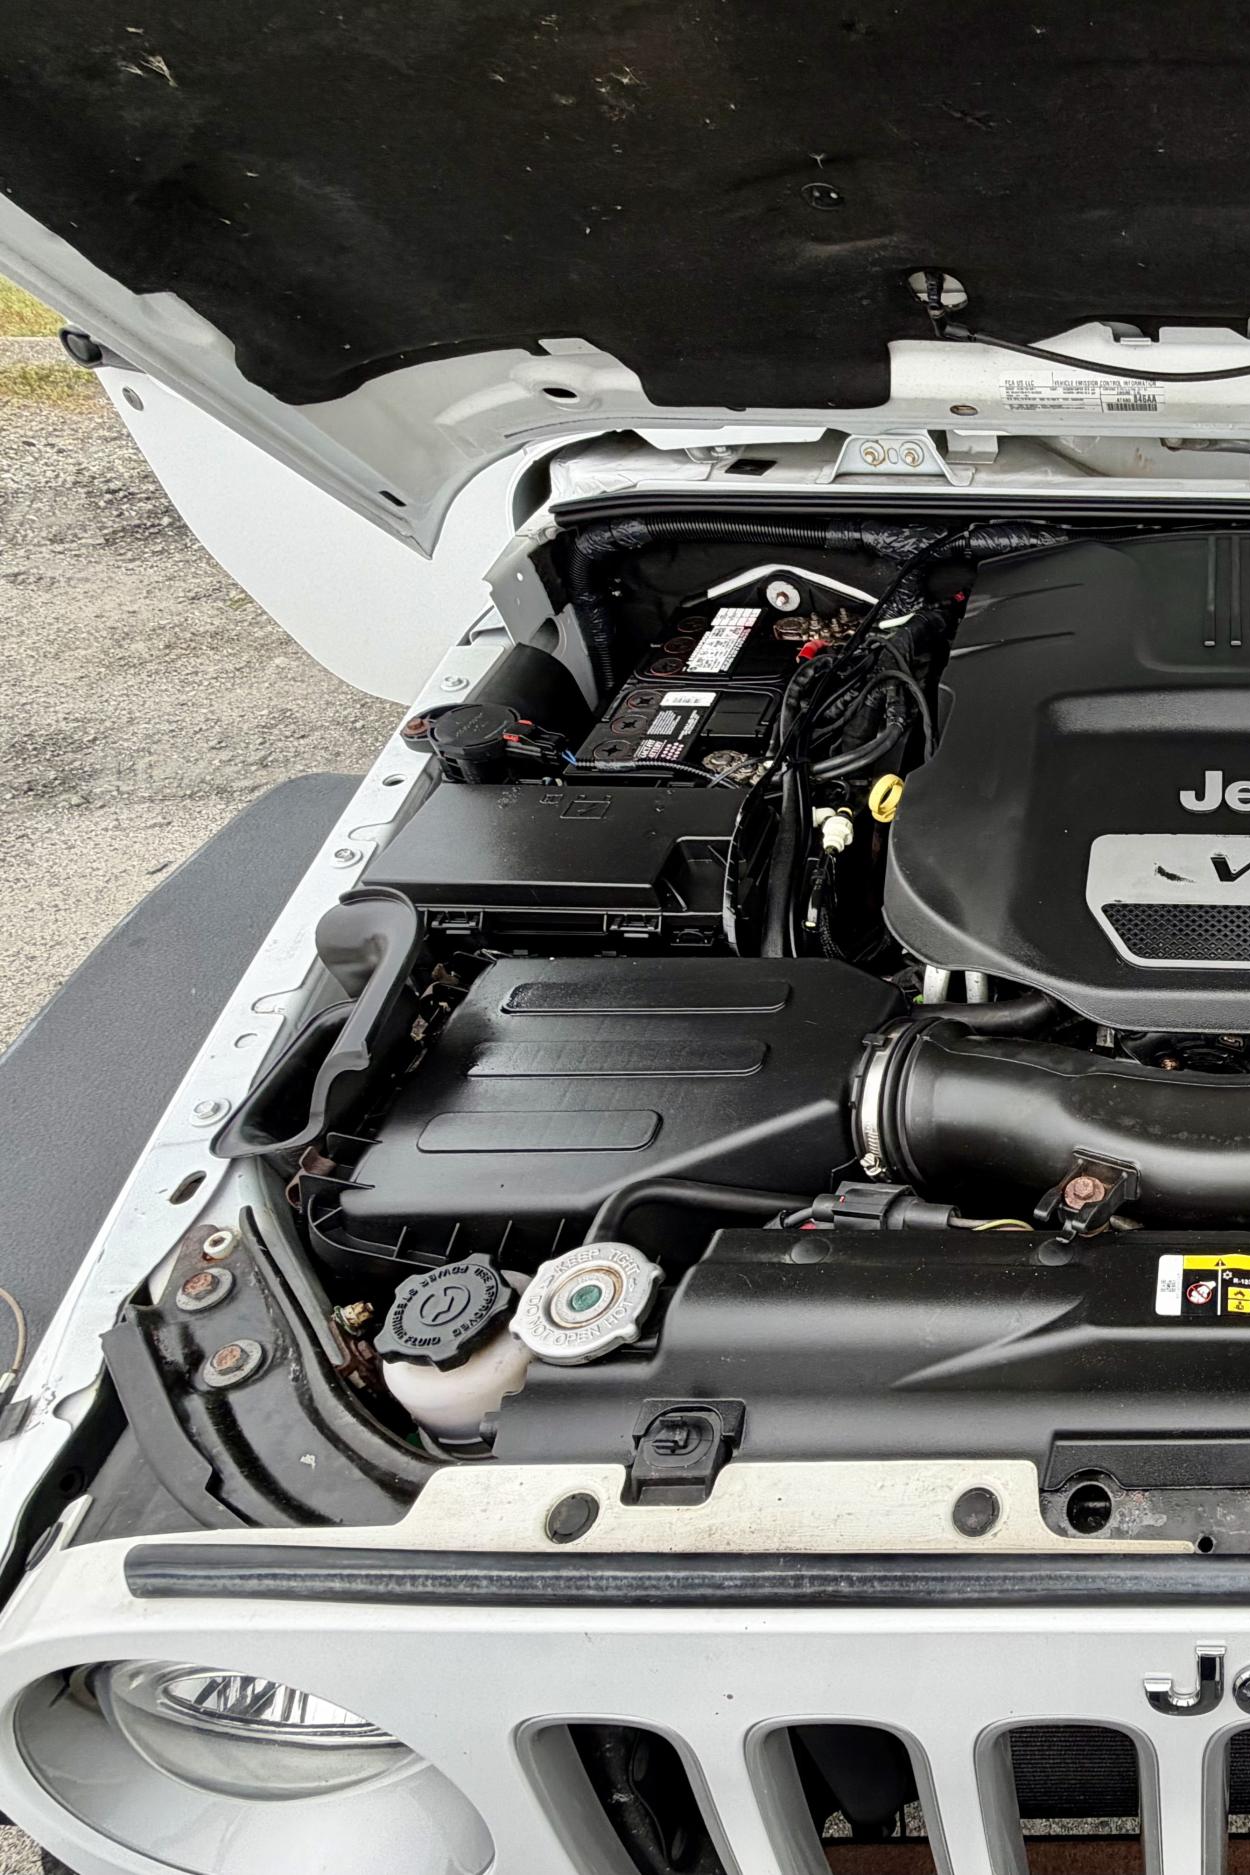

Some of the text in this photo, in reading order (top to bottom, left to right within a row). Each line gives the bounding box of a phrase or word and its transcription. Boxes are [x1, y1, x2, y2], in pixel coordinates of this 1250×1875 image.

[1054, 379, 1157, 387] VEHICLE EMISSION CONTROL INFORMATION
[555, 1249, 600, 1275] KEEP
[391, 1264, 470, 1348] POWER STEERING FLUID
[451, 1267, 495, 1338] USE APPROVED
[527, 1294, 634, 1346] DO NOT OPEN HOT
